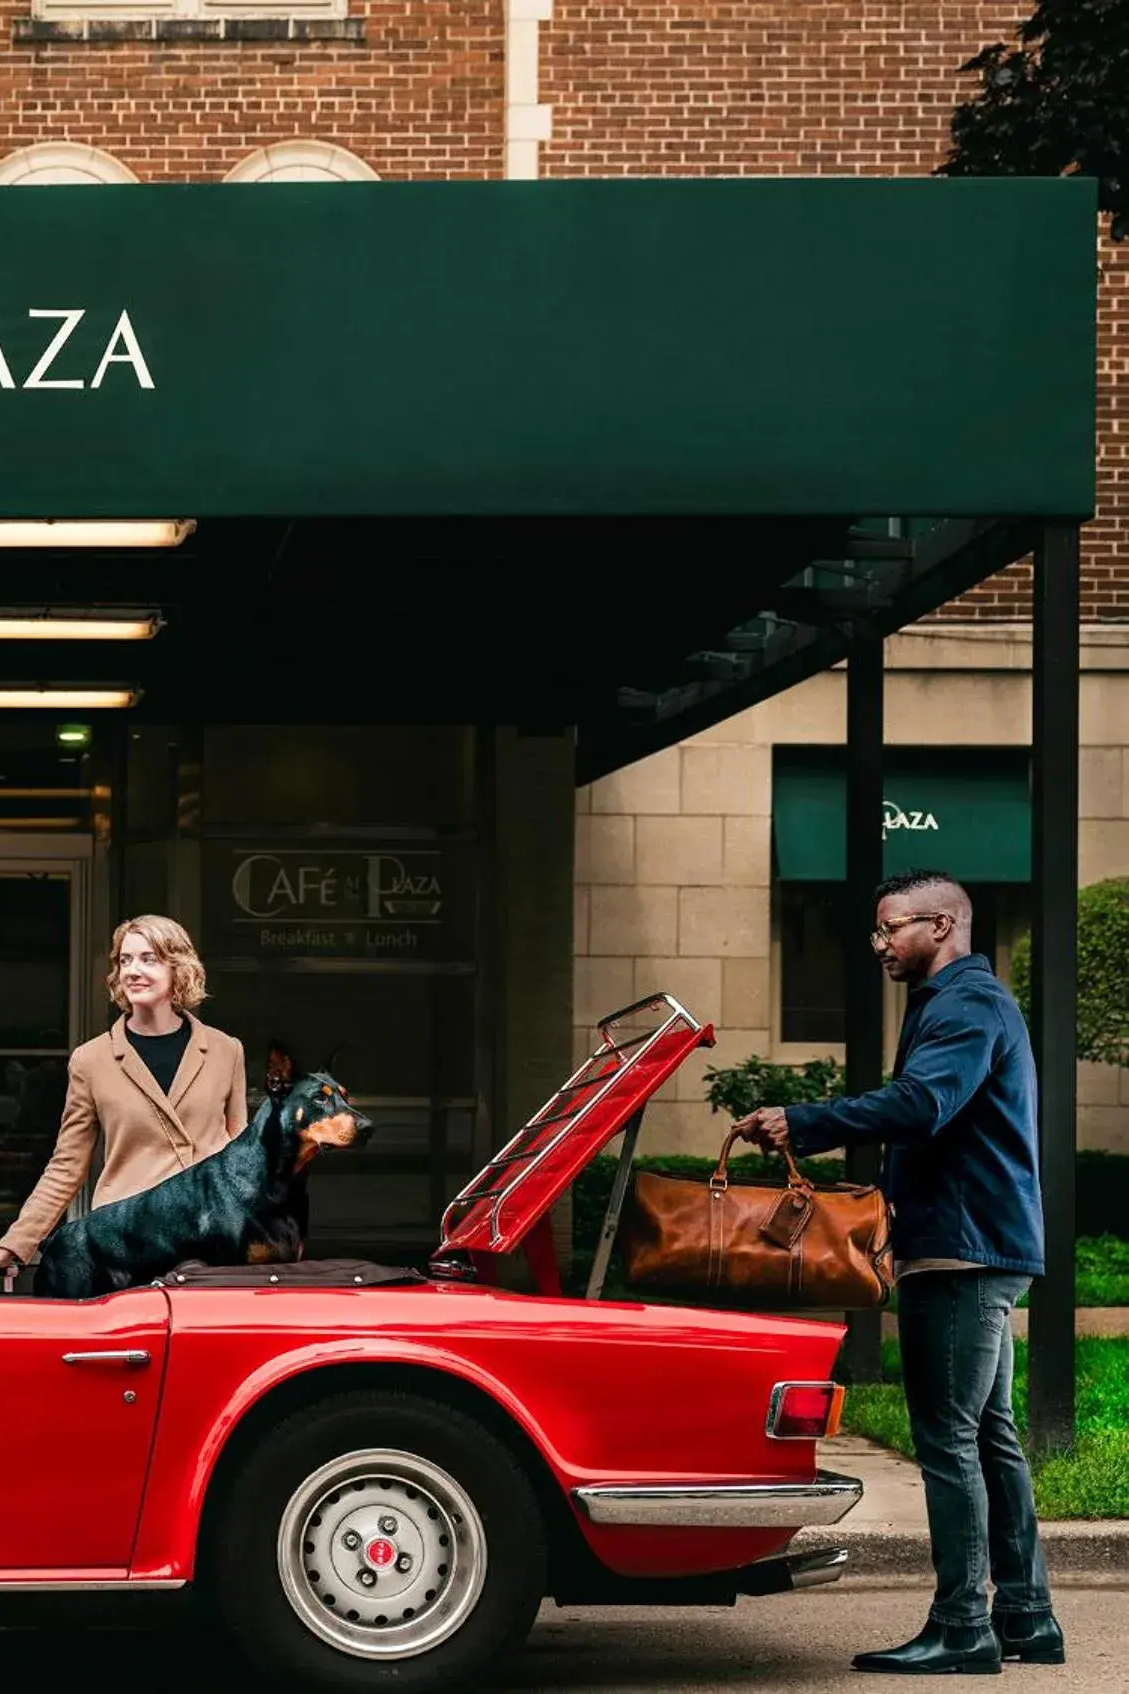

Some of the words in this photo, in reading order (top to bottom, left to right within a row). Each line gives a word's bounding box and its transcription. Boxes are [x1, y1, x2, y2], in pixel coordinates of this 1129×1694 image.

[362, 855, 442, 918] PLAZA
[260, 929, 335, 947] Breakfast
[366, 929, 417, 947] Lunch
